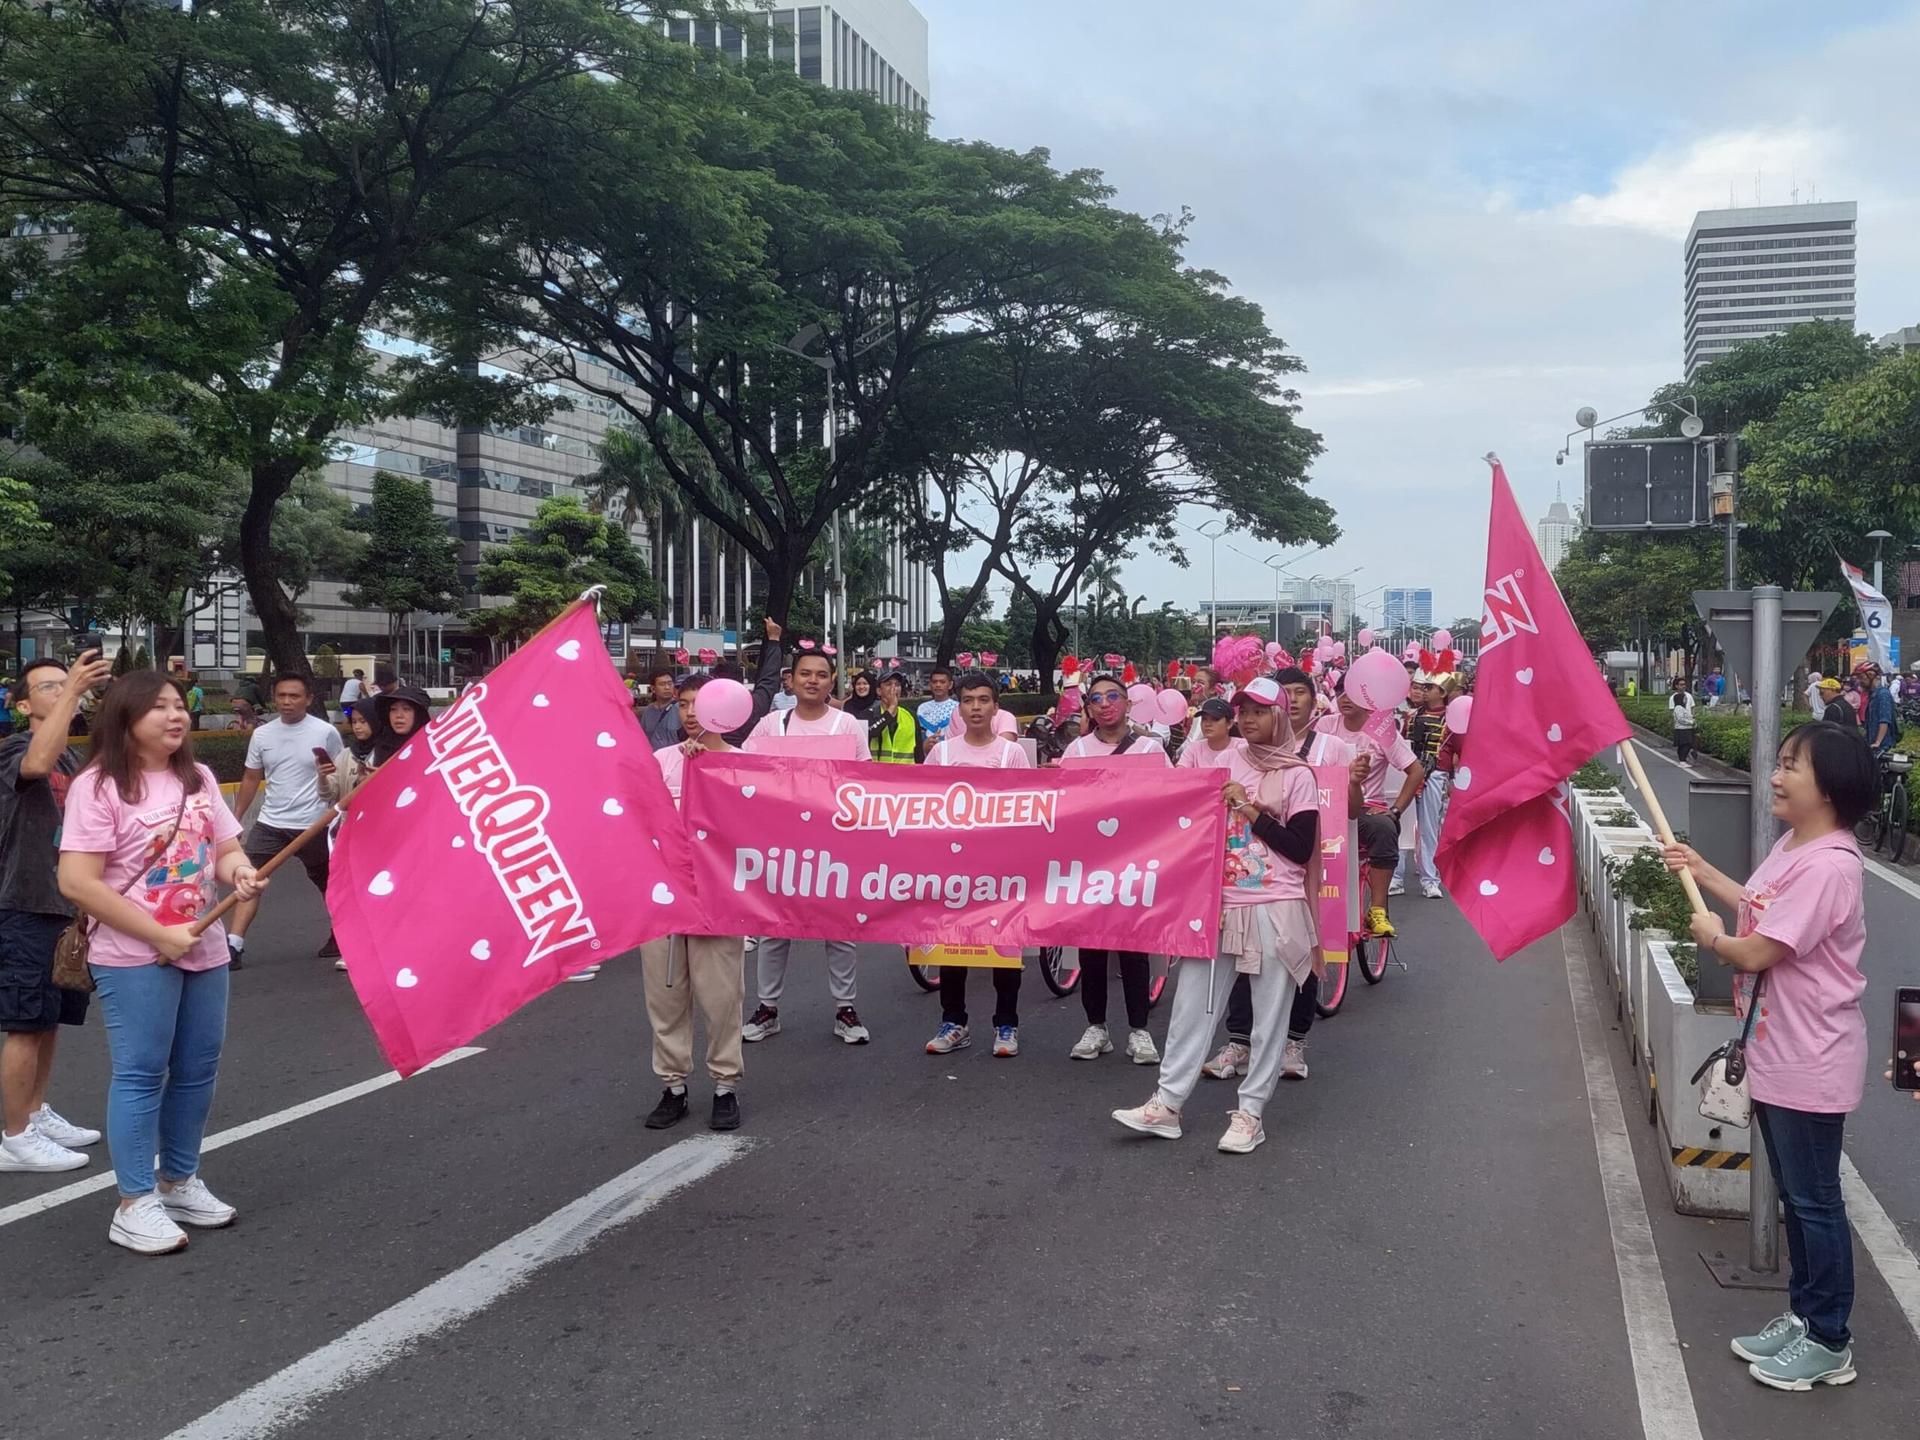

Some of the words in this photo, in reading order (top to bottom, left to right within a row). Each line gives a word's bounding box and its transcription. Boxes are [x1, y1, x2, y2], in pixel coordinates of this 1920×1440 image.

[832, 782, 1058, 837] SILVERQUEEN
[733, 847, 849, 899] Pilih
[861, 864, 1027, 909] dengan
[1045, 859, 1161, 907] Hati
